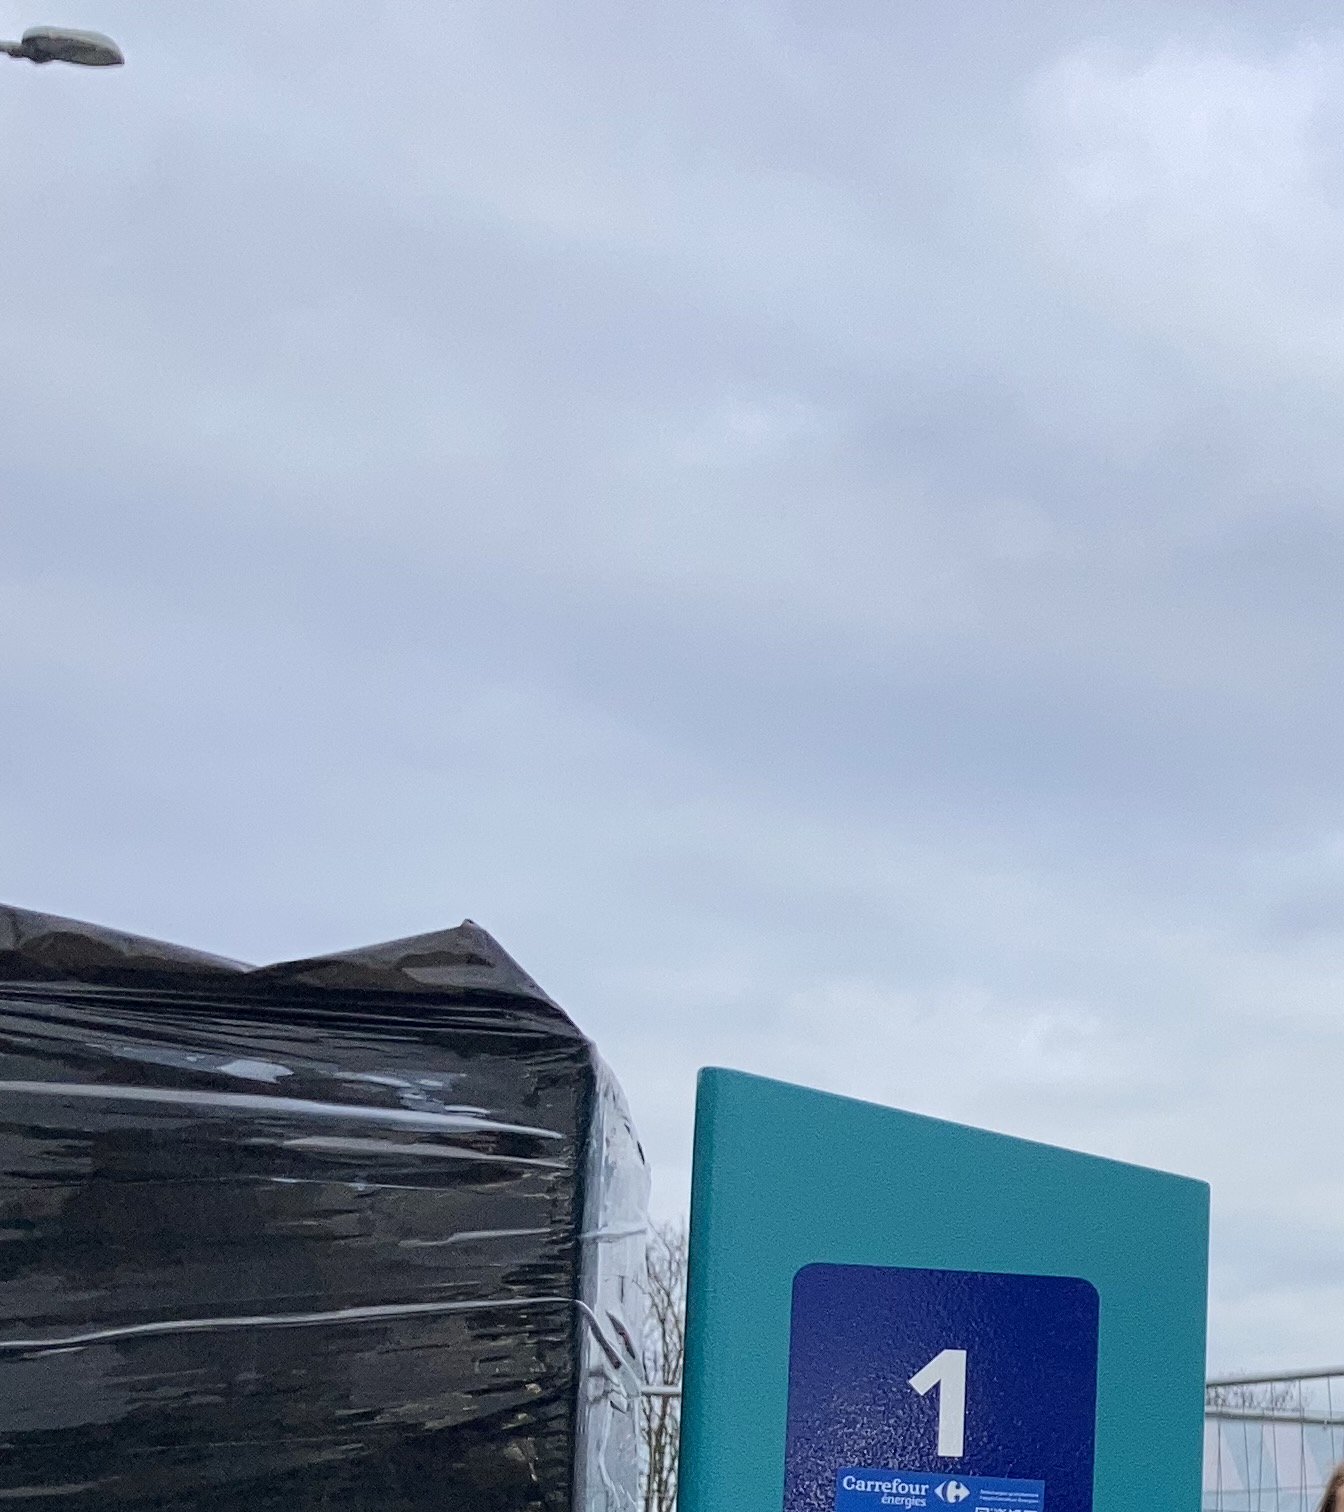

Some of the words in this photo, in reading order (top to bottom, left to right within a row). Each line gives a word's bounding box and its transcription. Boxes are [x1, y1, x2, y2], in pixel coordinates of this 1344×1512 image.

[908, 1348, 967, 1457] 1
[842, 1475, 929, 1495] Carrefour
[881, 1493, 927, 1510] énergies
